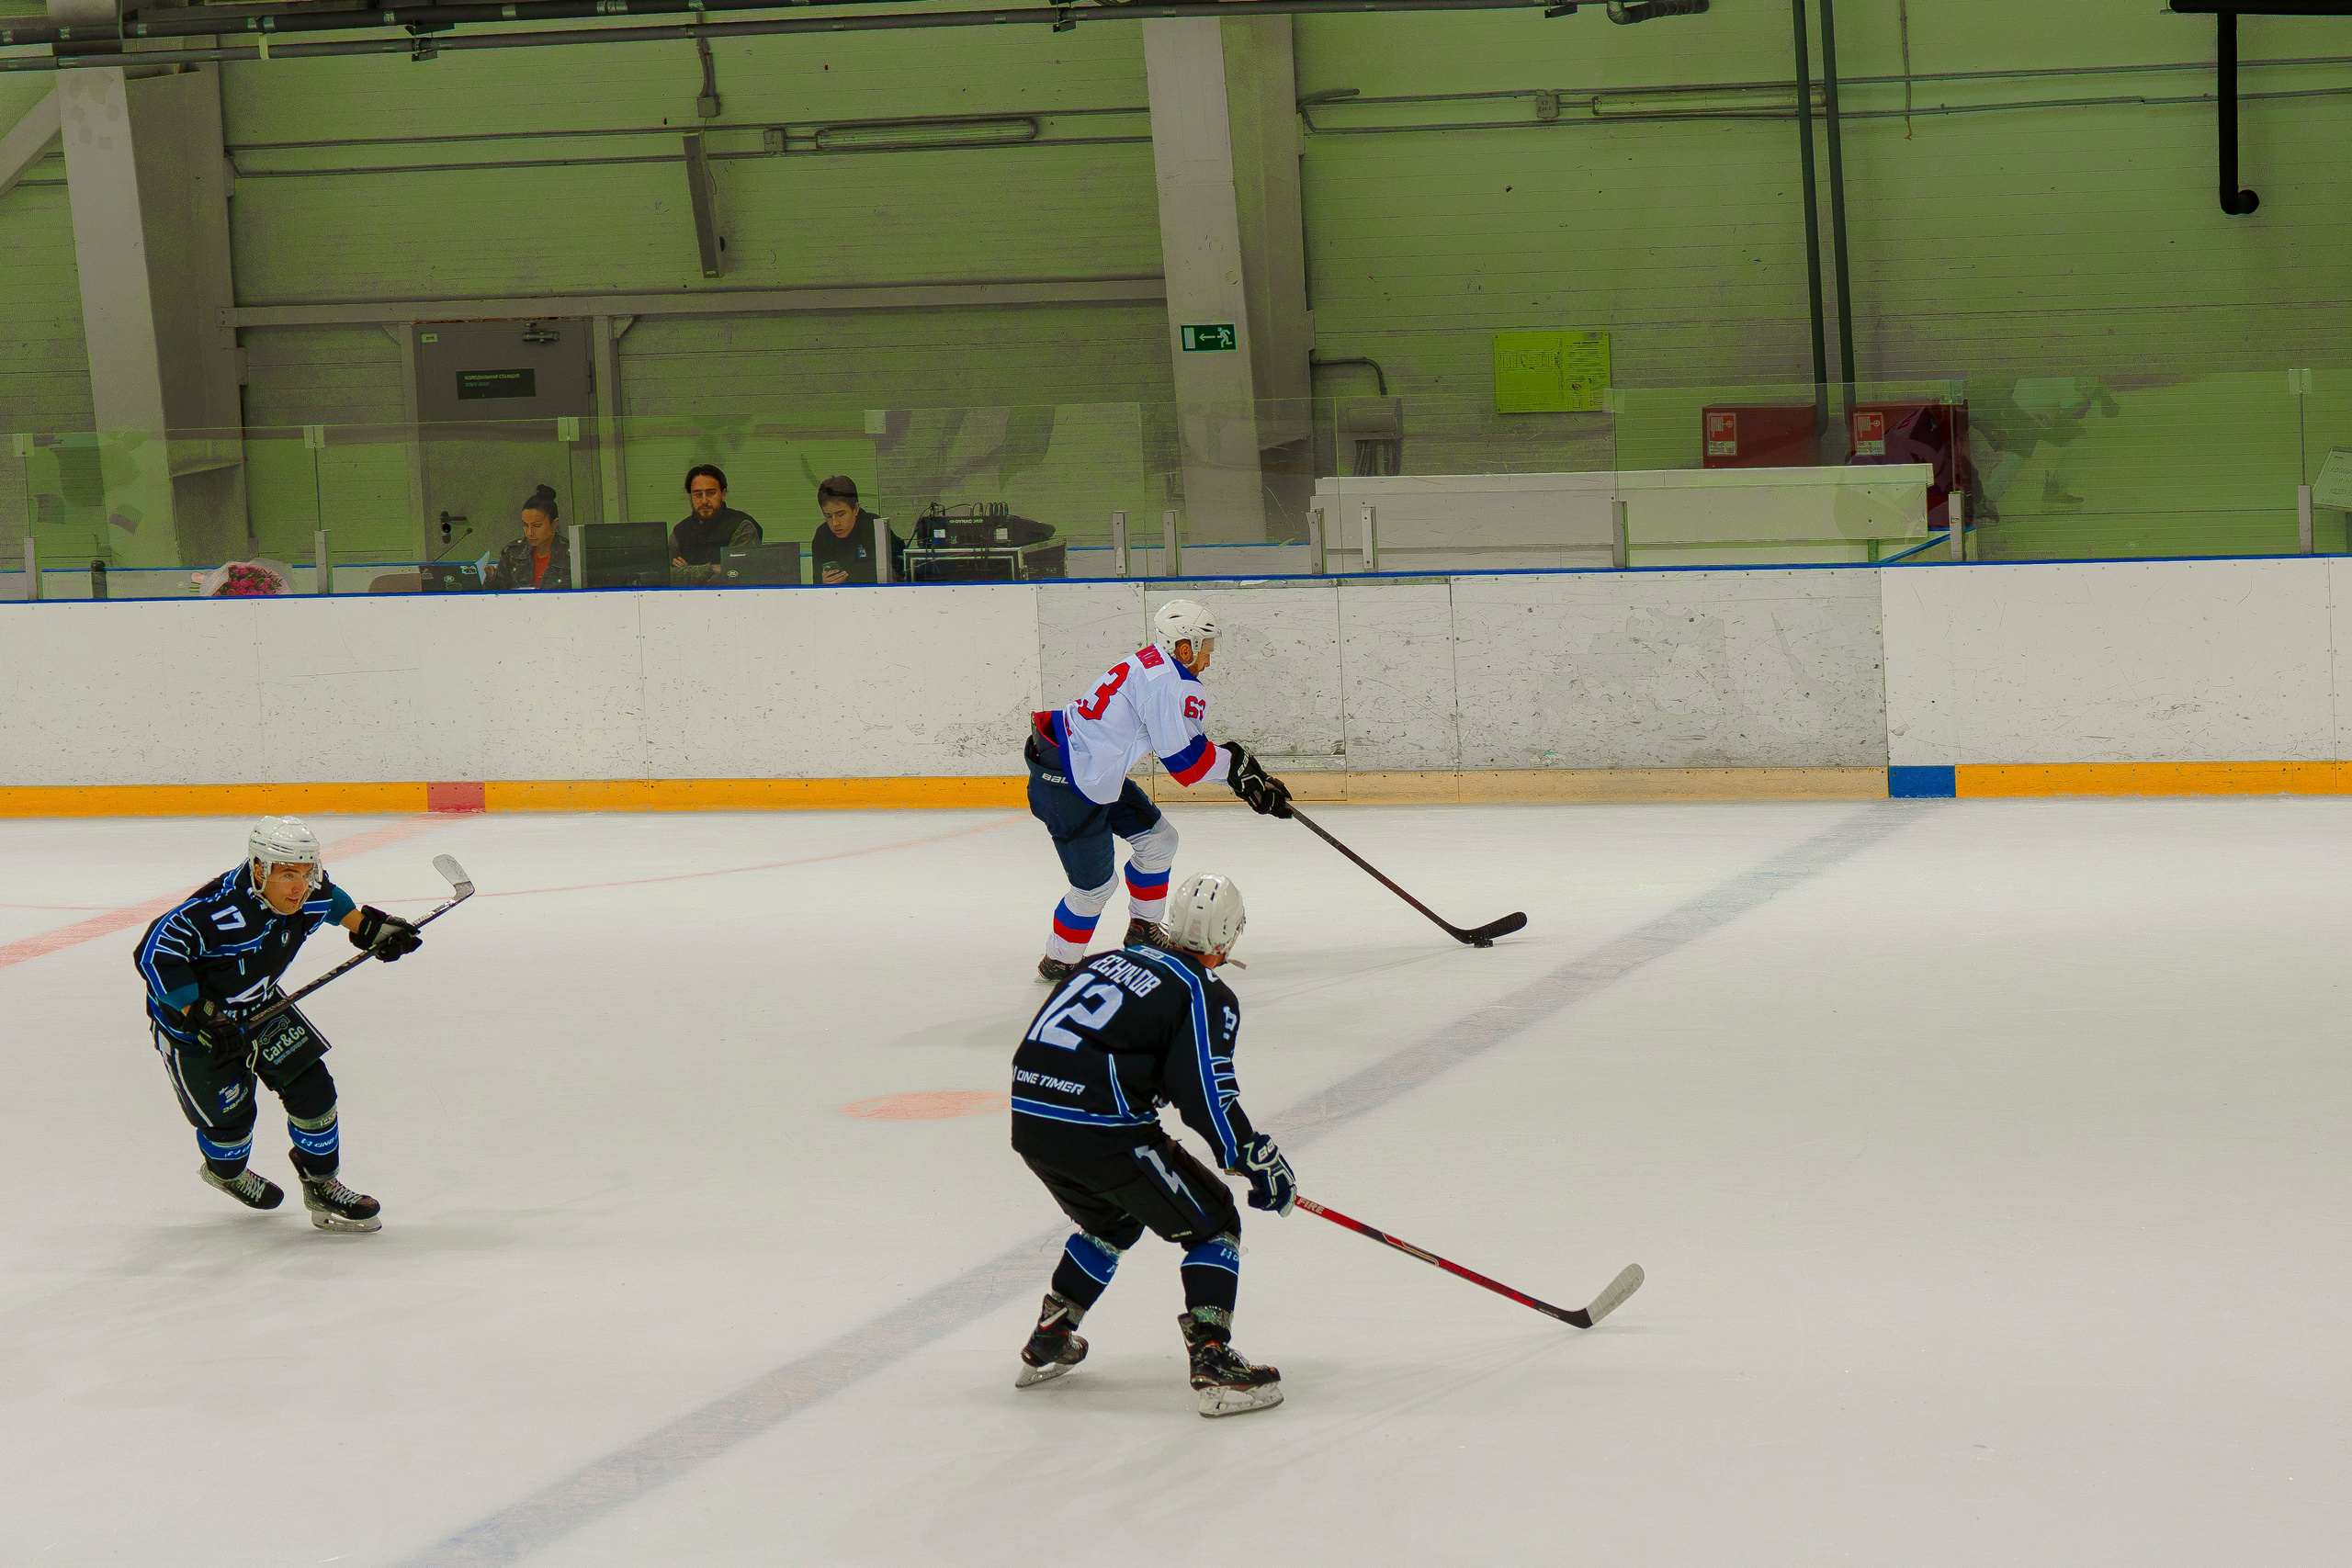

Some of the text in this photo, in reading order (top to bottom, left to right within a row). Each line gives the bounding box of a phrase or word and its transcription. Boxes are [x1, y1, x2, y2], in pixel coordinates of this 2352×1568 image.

[210, 905, 247, 931] 17
[1027, 972, 1124, 1051] 12
[262, 1025, 306, 1062] Car&Go
[1016, 1069, 1086, 1096] ONE TIMER
[1296, 1197, 1326, 1215] FIRE
